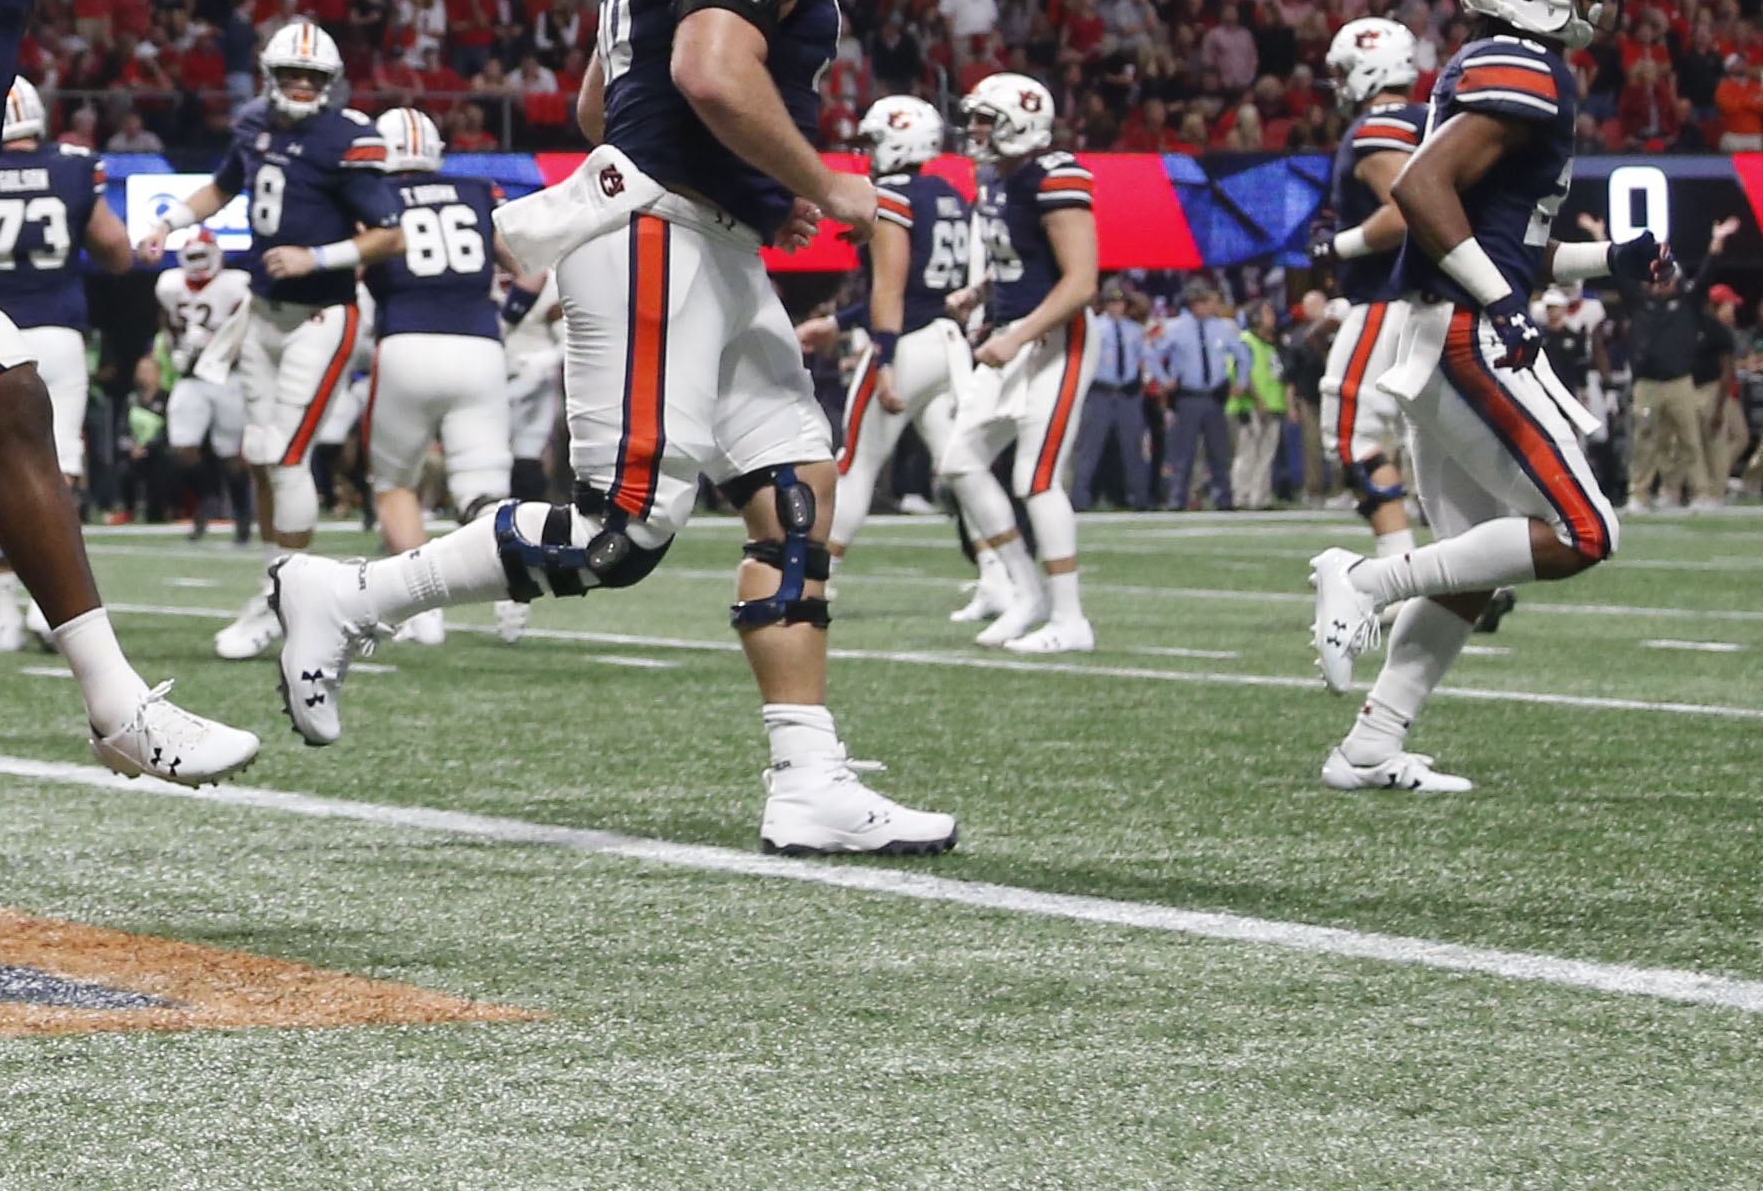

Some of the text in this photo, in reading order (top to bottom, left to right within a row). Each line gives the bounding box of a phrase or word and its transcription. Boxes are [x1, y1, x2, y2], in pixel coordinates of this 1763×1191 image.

[252, 164, 286, 236] 8
[1609, 166, 1668, 247] 0
[400, 204, 486, 276] 86
